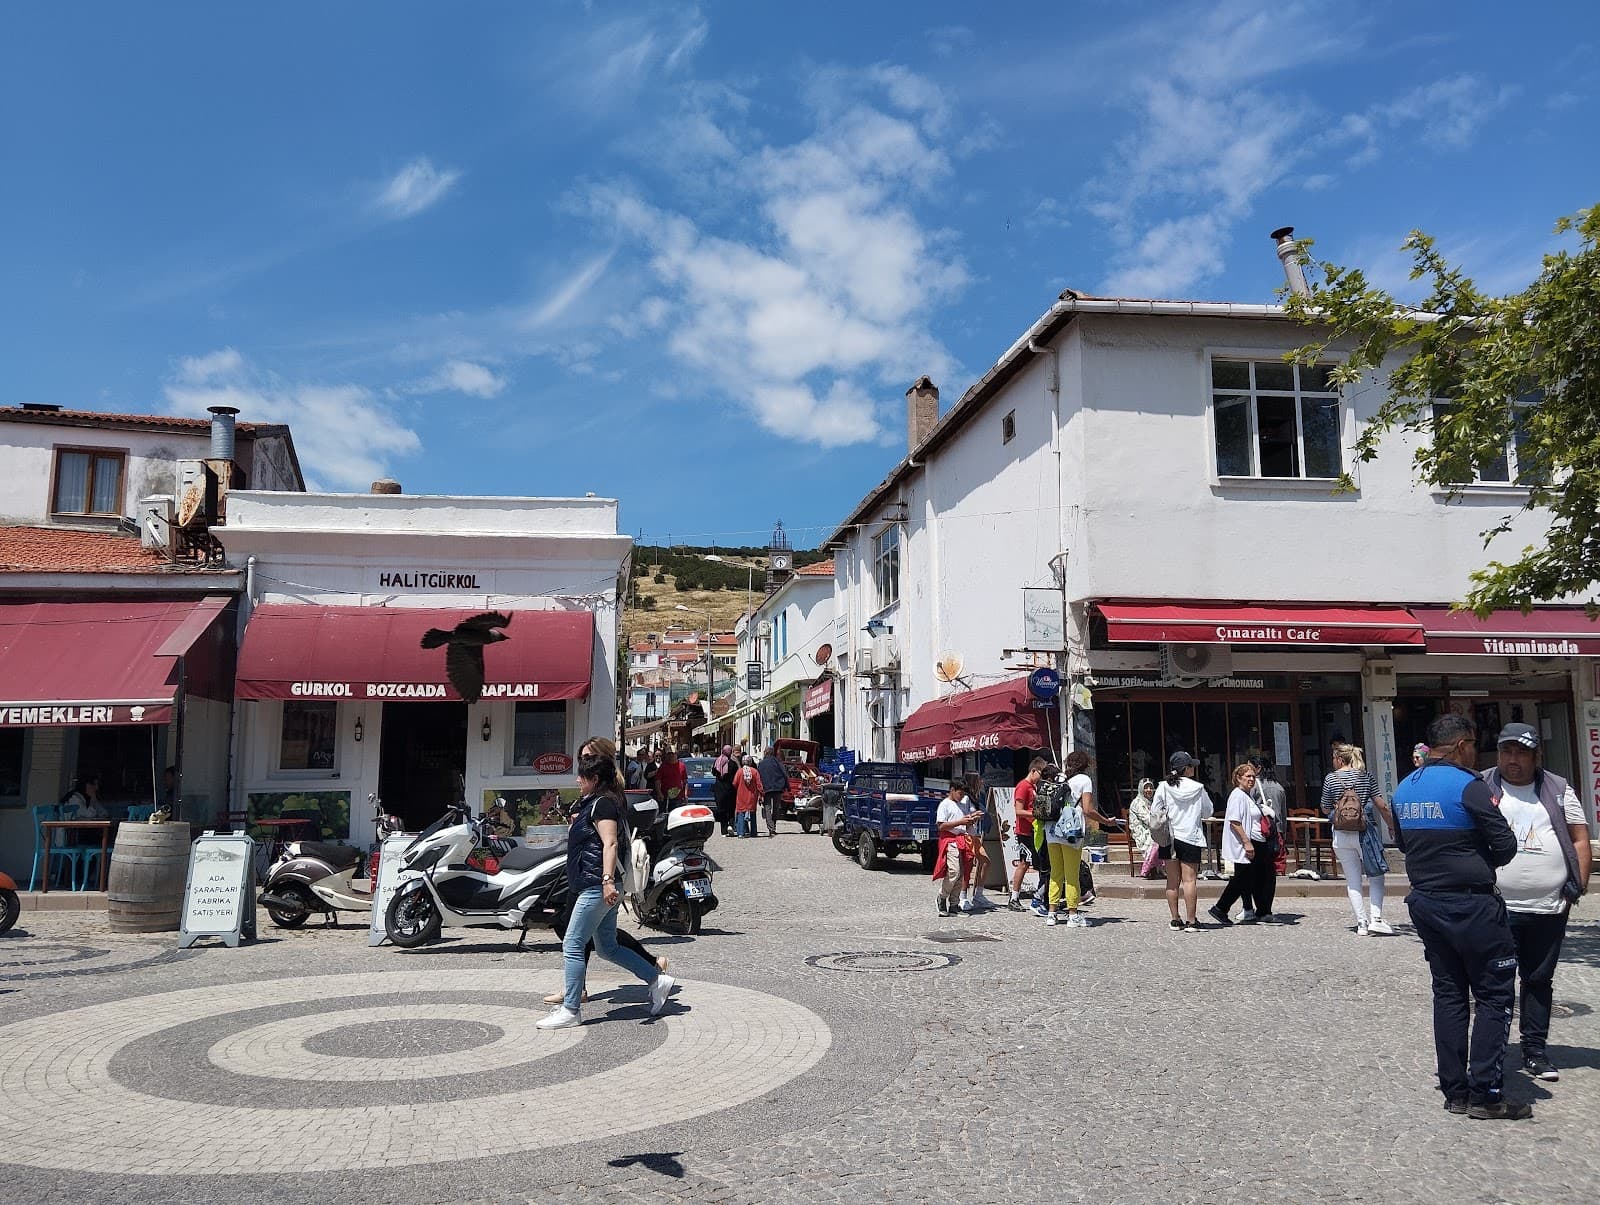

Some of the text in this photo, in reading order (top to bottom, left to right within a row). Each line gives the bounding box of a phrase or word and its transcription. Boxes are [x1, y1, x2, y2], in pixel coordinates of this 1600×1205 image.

[1216, 626, 1282, 641] Çınaraltı
[366, 683, 446, 697] BOZCAADA
[480, 683, 539, 697] RAPLARI
[0, 706, 113, 724] YEMEKLERİ
[397, 874, 412, 882] ADA
